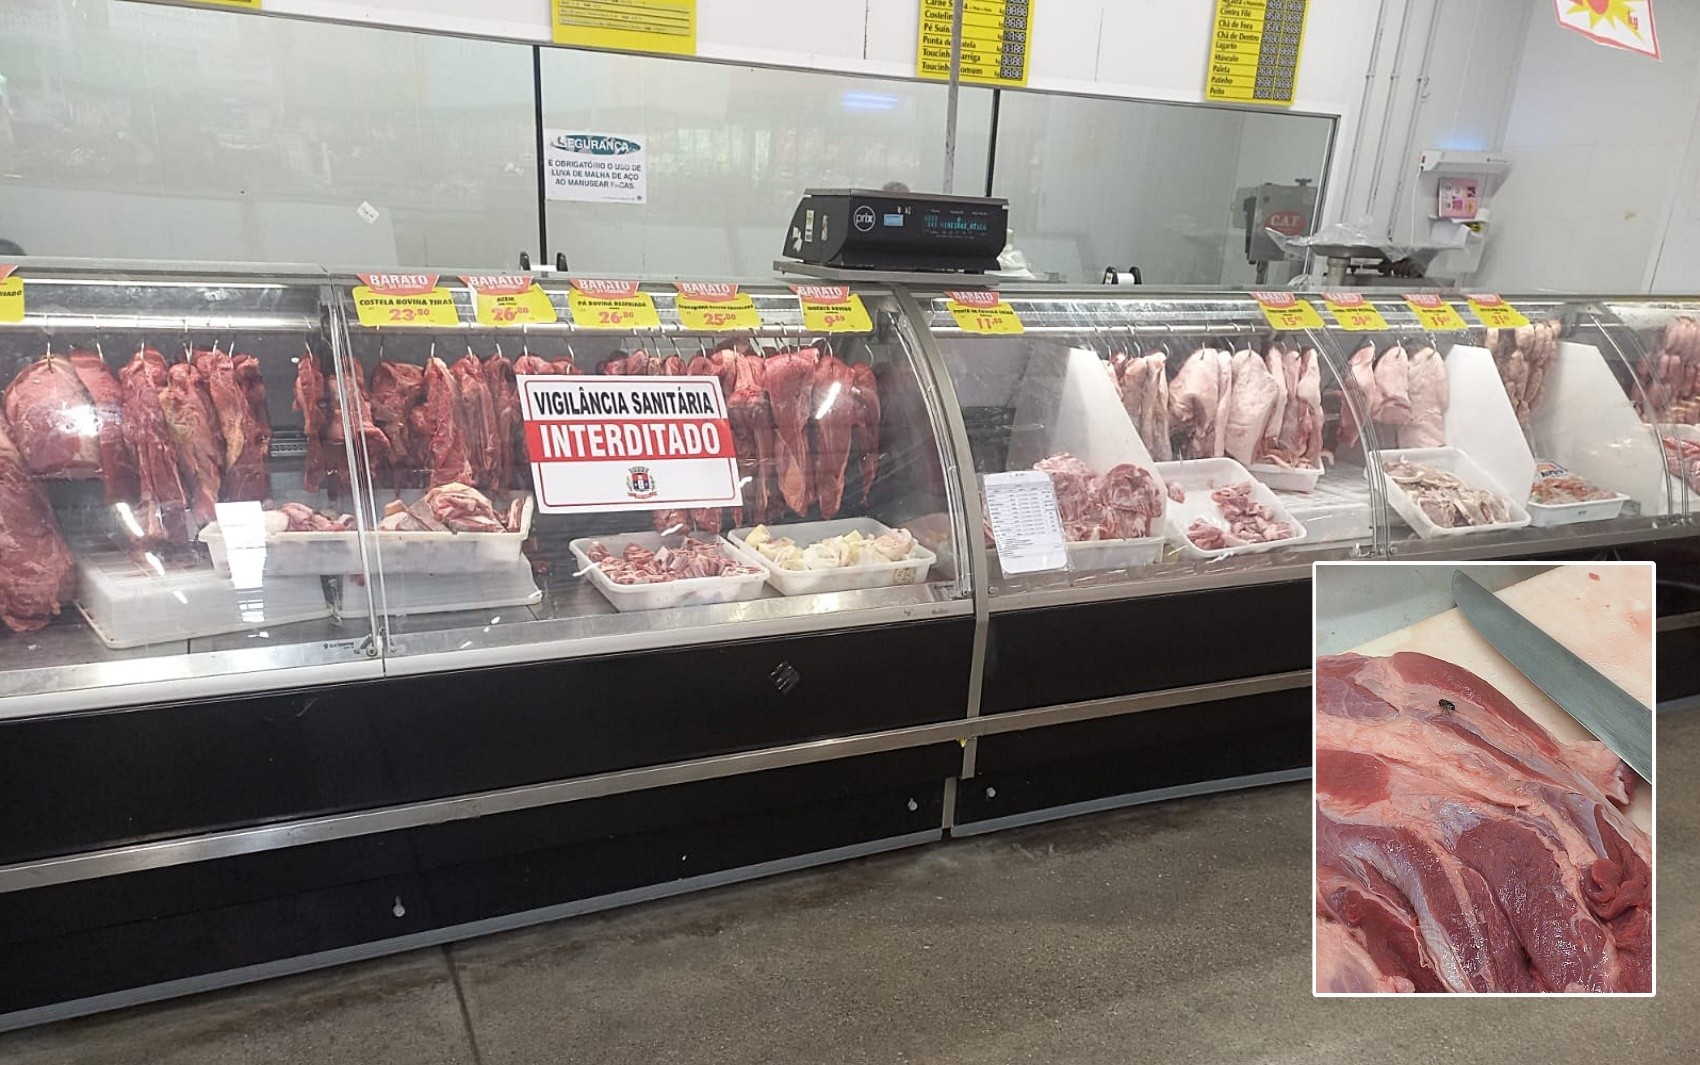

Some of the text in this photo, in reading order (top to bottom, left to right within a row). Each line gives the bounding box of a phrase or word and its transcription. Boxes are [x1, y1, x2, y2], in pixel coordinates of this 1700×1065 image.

[925, 10, 952, 20] Costelin
[935, 24, 950, 33] Suín
[923, 36, 943, 46] Ponta
[1240, 33, 1260, 41] Dentro
[923, 48, 950, 58] Toucinh
[962, 53, 980, 64] arriga
[922, 61, 950, 71] Toucinh
[558, 136, 629, 153] SEGURANÇA
[555, 160, 605, 169] OBRIGATÓRIO
[568, 179, 608, 188] MANUSEAR
[856, 213, 873, 223] prix
[369, 275, 428, 285] BARATO
[469, 276, 524, 286] BARATO
[578, 280, 630, 290] BARATO
[682, 283, 730, 292] BARATO
[798, 286, 842, 296] BARATO
[952, 292, 993, 300] BARATO
[534, 387, 714, 416] VIGILÂNCIA SANITÁRIA
[540, 422, 720, 458] INTERDITADO
